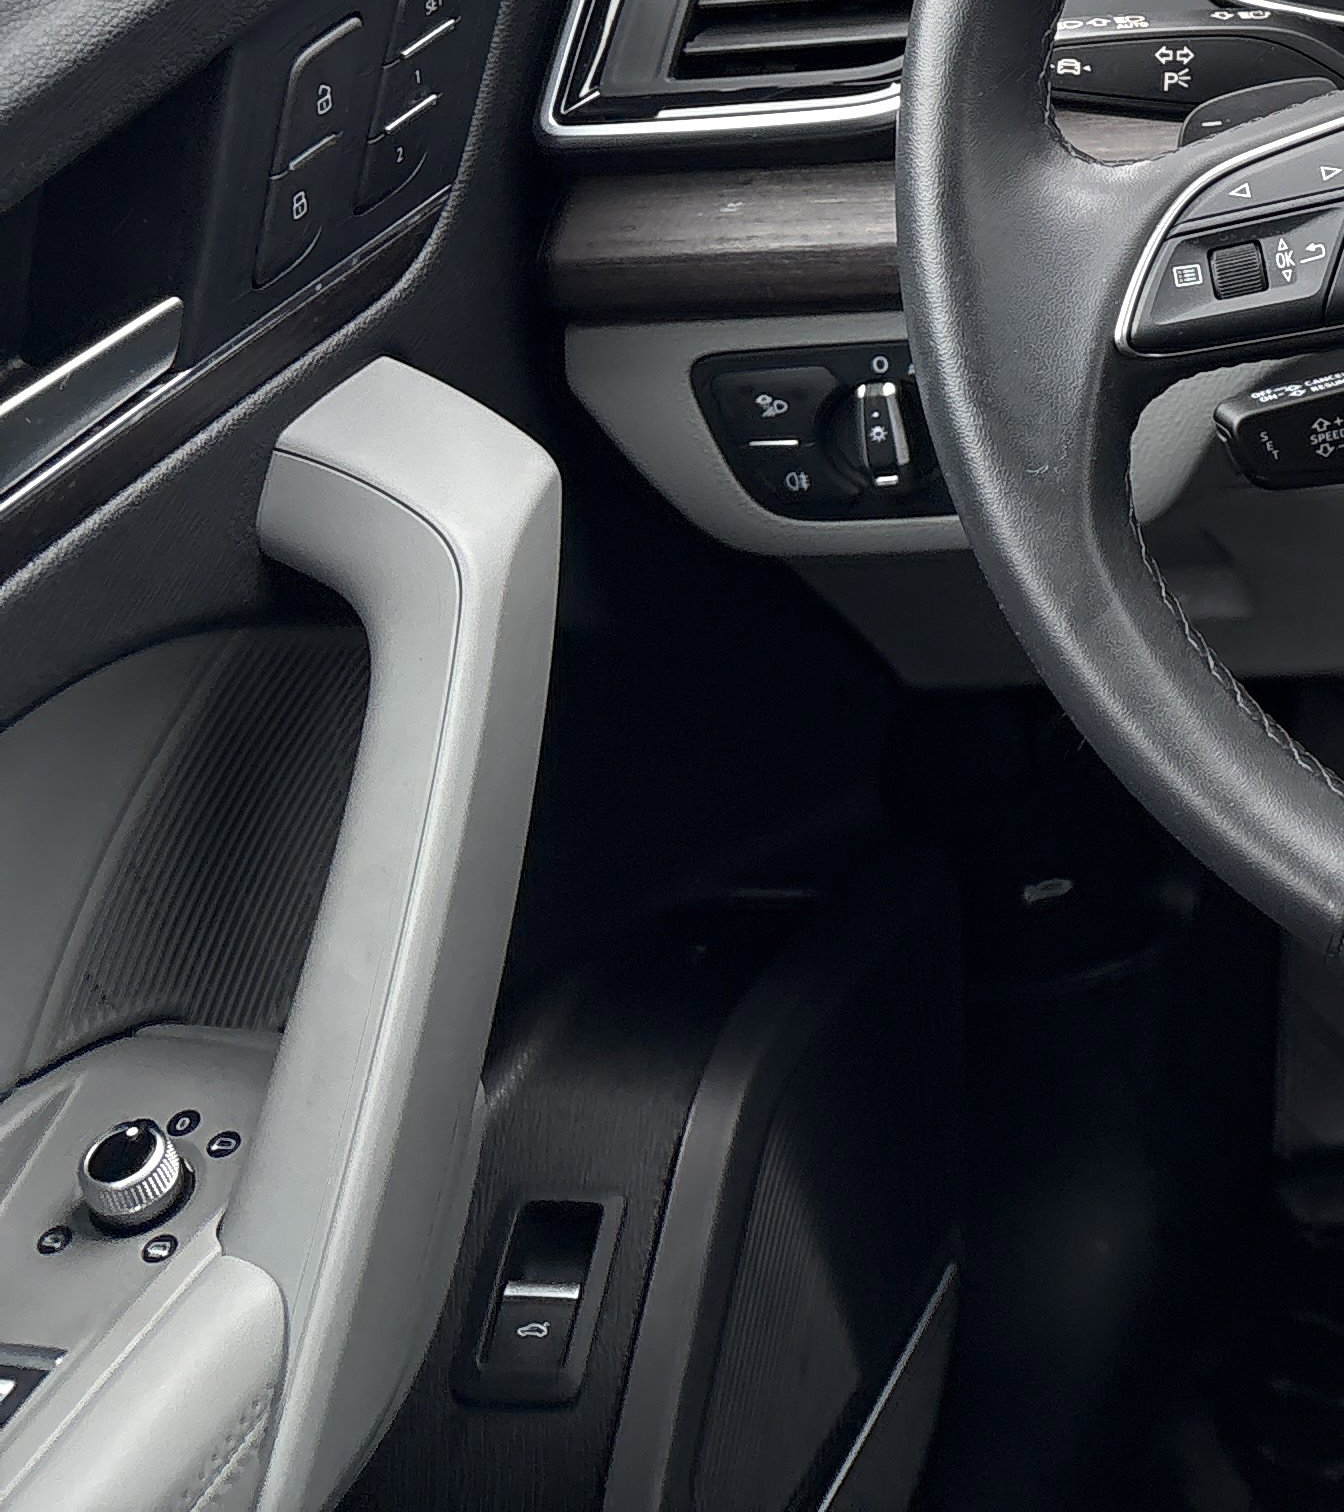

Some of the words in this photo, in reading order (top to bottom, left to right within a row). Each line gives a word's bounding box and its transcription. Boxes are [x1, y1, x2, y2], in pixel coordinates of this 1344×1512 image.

[414, 69, 421, 84] 1
[396, 147, 405, 163] 2
[1275, 250, 1295, 269] OK
[1259, 431, 1279, 460] SET
